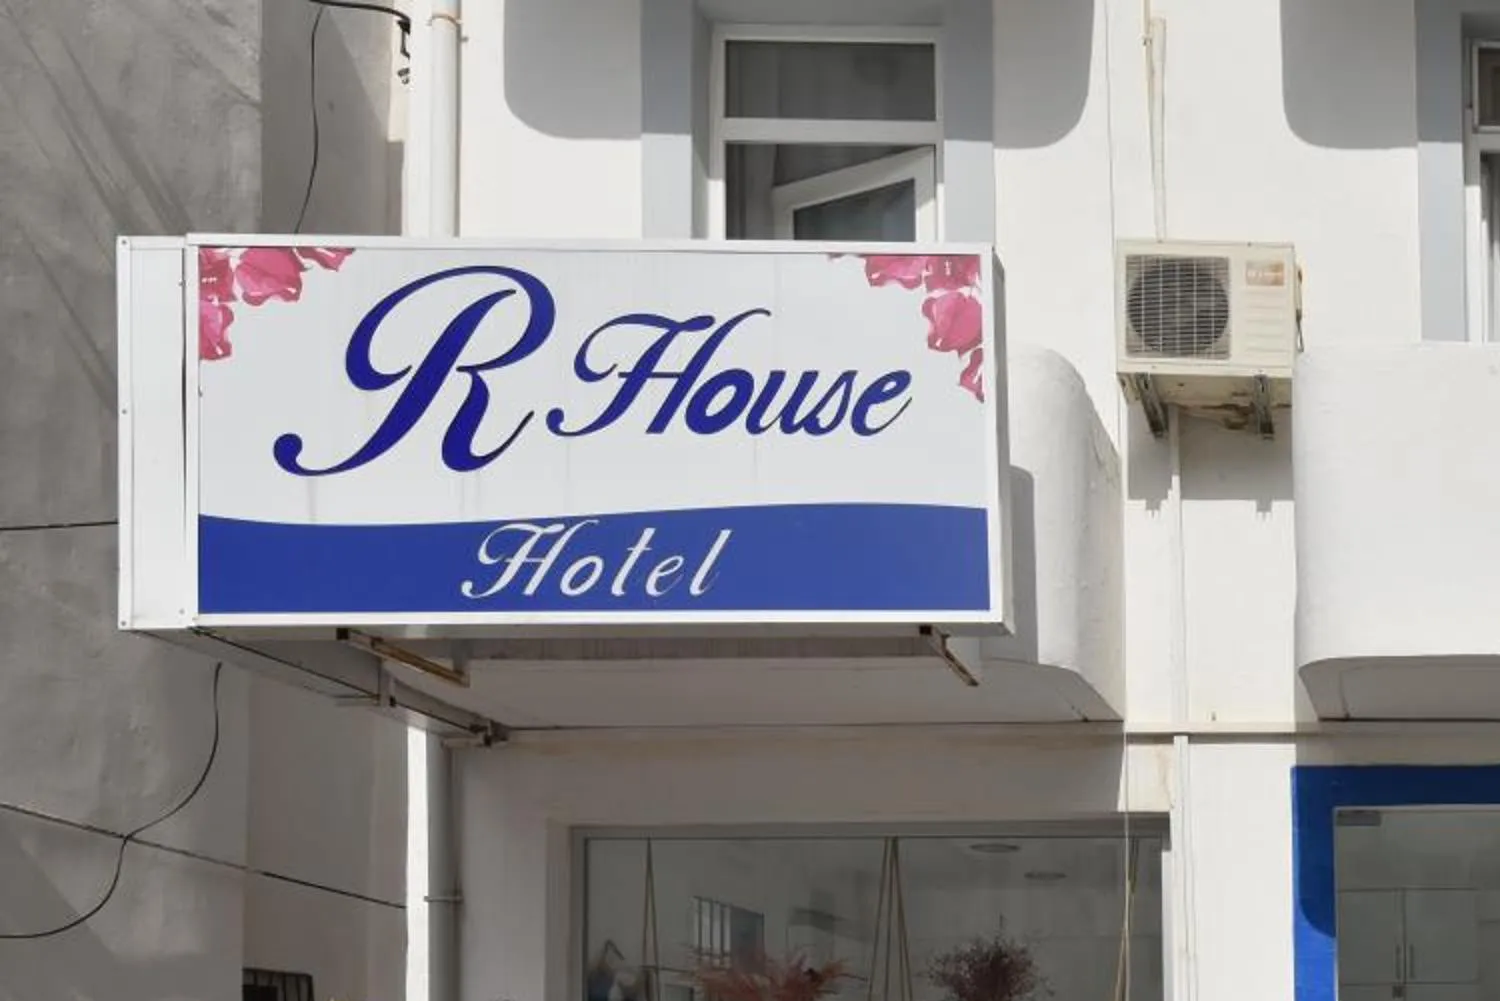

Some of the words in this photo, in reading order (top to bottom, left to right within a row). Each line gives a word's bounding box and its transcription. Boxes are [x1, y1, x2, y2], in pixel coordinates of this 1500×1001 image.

[272, 264, 556, 478] R
[544, 308, 914, 437] House
[461, 518, 732, 599] Hotel
